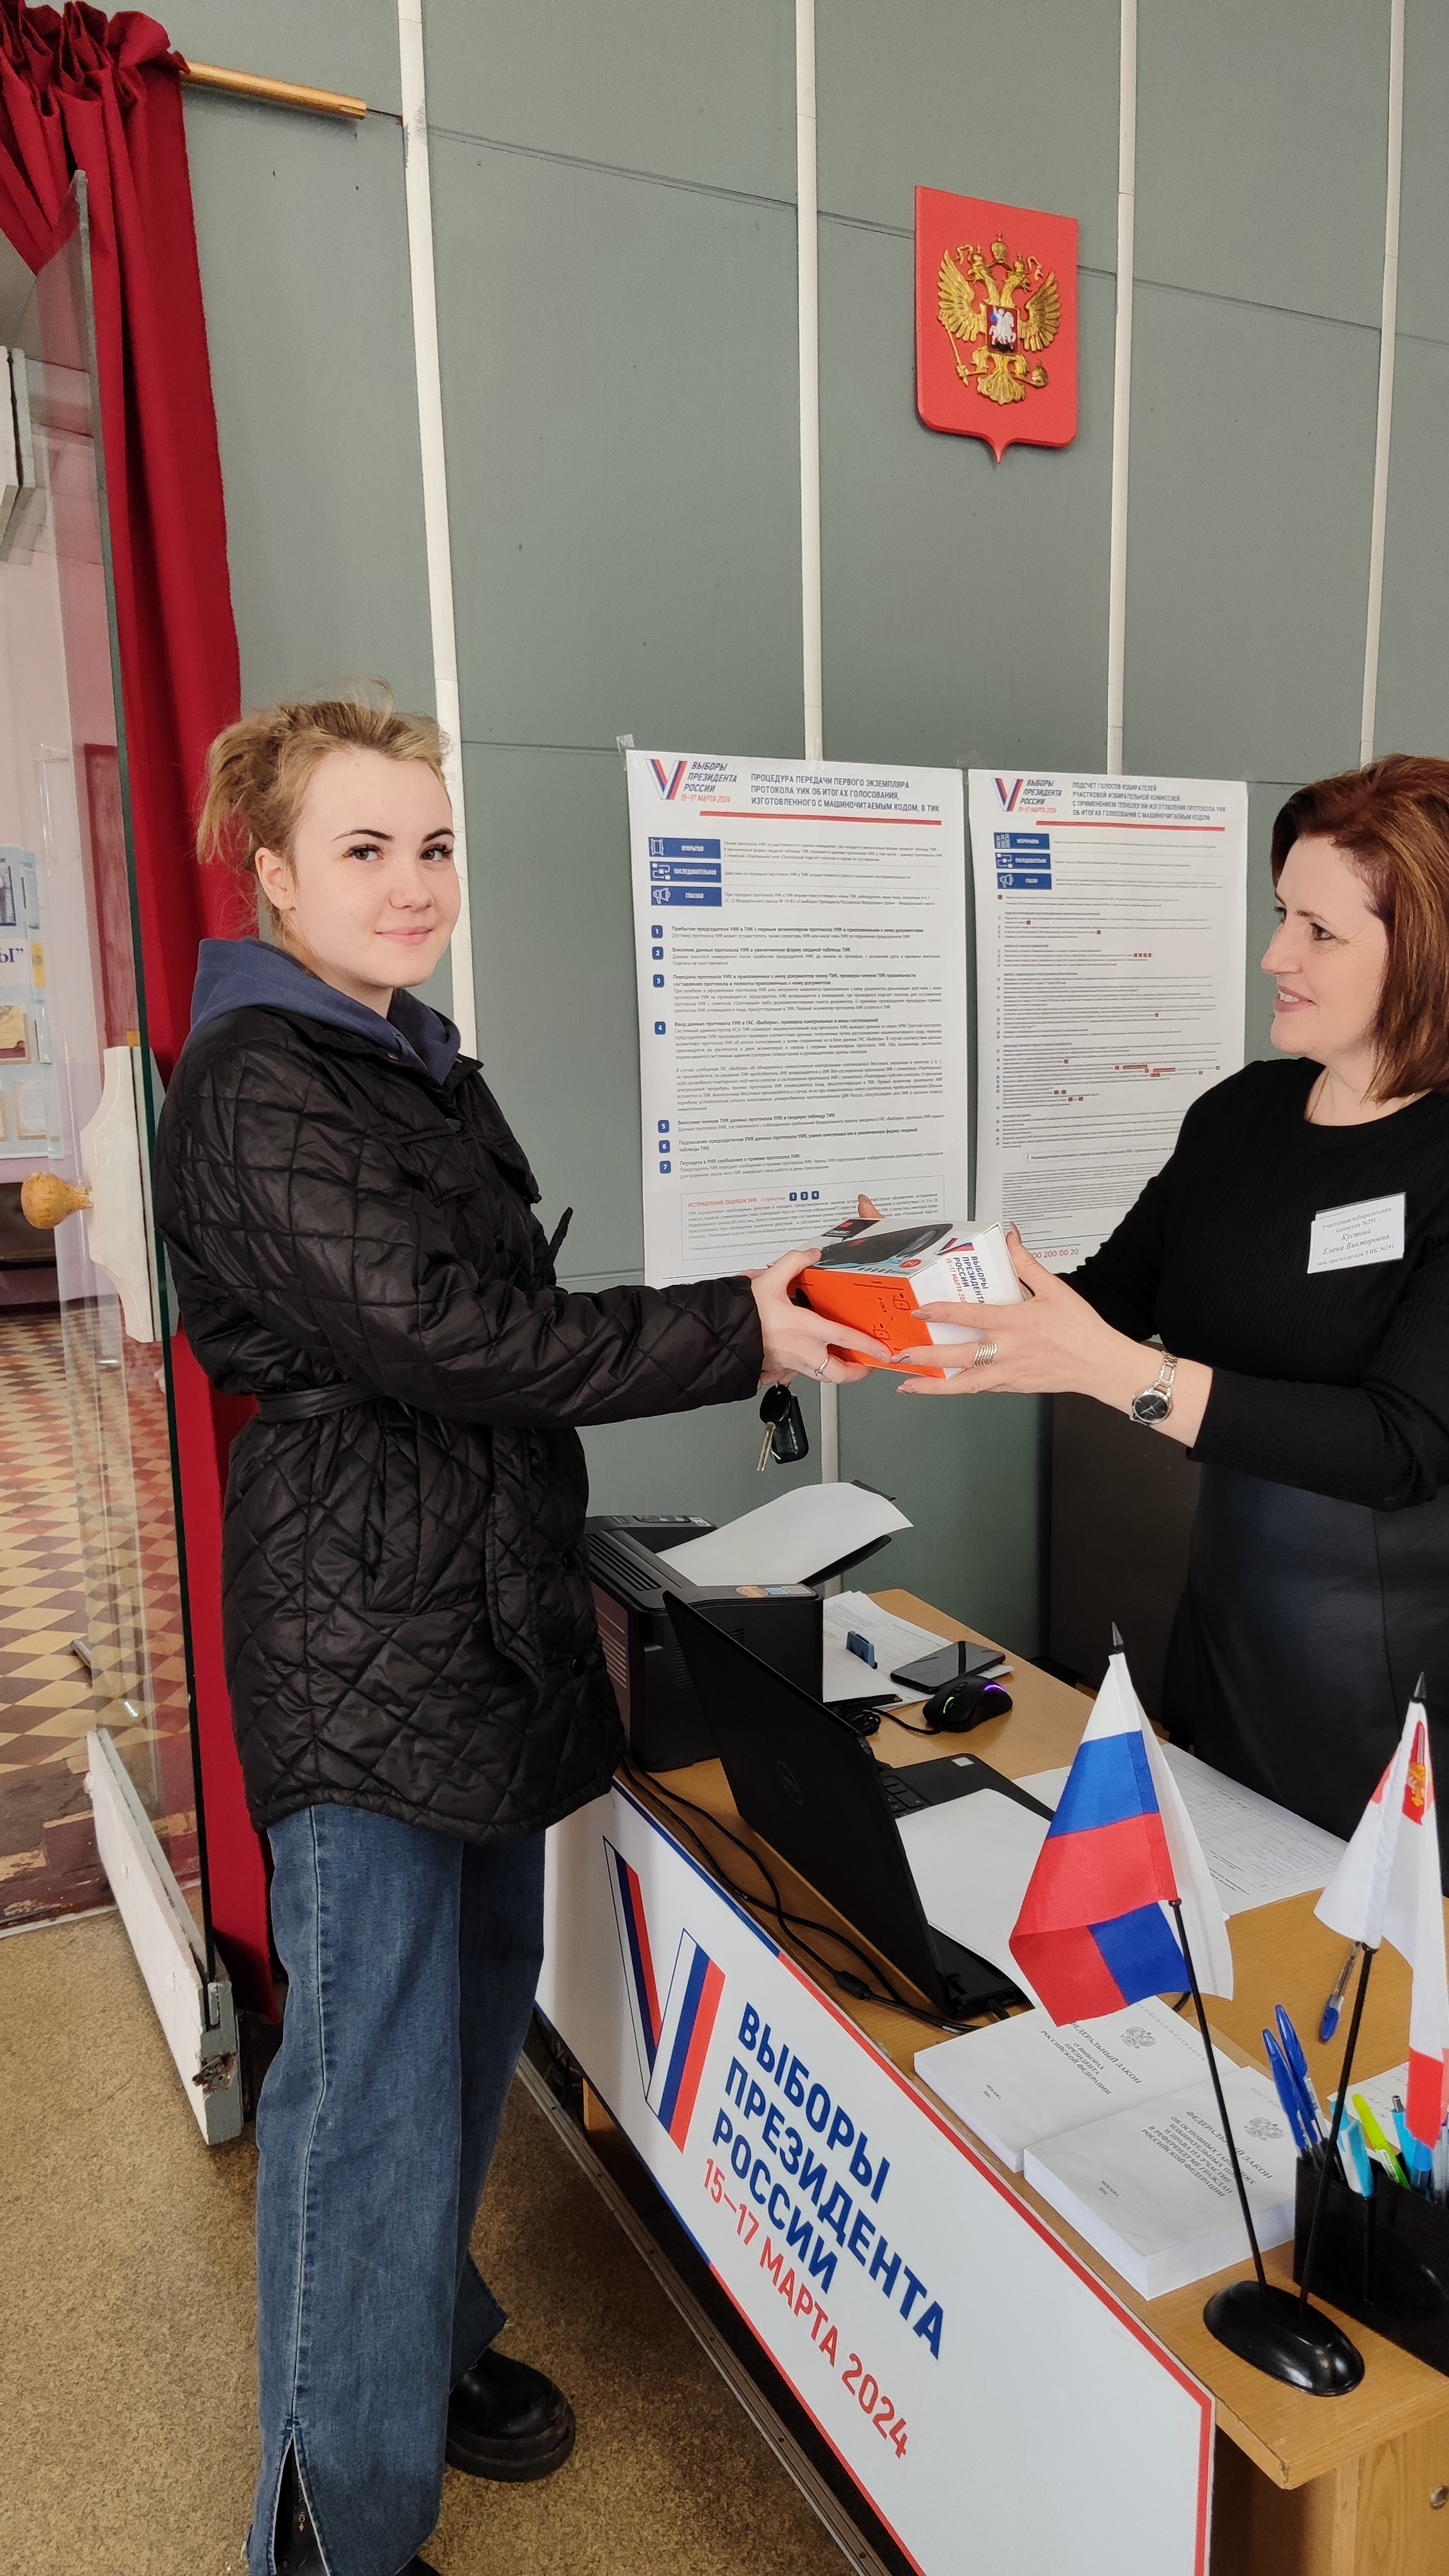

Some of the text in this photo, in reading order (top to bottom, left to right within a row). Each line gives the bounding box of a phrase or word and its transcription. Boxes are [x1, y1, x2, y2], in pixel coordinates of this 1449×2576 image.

[687, 773, 737, 782] ПРЕЗИДЕНТА
[692, 762, 728, 771] ВЫБОРЫ
[684, 784, 716, 792] РОССИИ
[752, 774, 909, 789] ПРОЦЕДУРА ПЕРЕДАЧИ ПЕРВОГО ЭКЗЕМПЛЯРА
[752, 786, 794, 794] ПРОТОКОЛА
[823, 789, 848, 797] ИТОГАХ
[850, 790, 899, 800] ГОЛОСОВАНИЯ,
[1023, 789, 1062, 797] ПРЕЗИДЕНТА
[752, 797, 816, 806] ИЗГОТОВЛЕННОГО
[824, 801, 891, 811] МАШИНОЧИТАЕМЫМ
[894, 804, 919, 813] КОДОМ,
[1323, 1234, 1390, 1255] Елена Викторовна
[1341, 1229, 1371, 1241] Кустова
[953, 1258, 970, 1287] РОССИИ
[962, 1257, 985, 1304] ПРЕЗИДЕНТА
[971, 1256, 989, 1289] ВЫБОРЫ
[952, 1274, 962, 1292] МАРТА
[958, 1293, 967, 1302] 202
[1040, 2029, 1112, 2095] РОССИЙСКОЙ ФЕДЕРАЦИИ
[1116, 2062, 1142, 2084] ЗАКОН
[738, 2001, 890, 2205] ВЫБОРЫ
[1169, 2132, 1191, 2151] ПРАВА
[1170, 2116, 1182, 2125] ОБ
[1180, 2123, 1218, 2155] ОСНОВНЫХ
[1186, 2110, 1274, 2179] ФЕДЕРАЛЬЙ ЗАКОН
[712, 2107, 840, 2296] РОССИИ
[724, 2055, 945, 2361] ПРЕЗИДЕНТА
[760, 2235, 838, 2367] МАРТА
[841, 2351, 909, 2459] 2024
